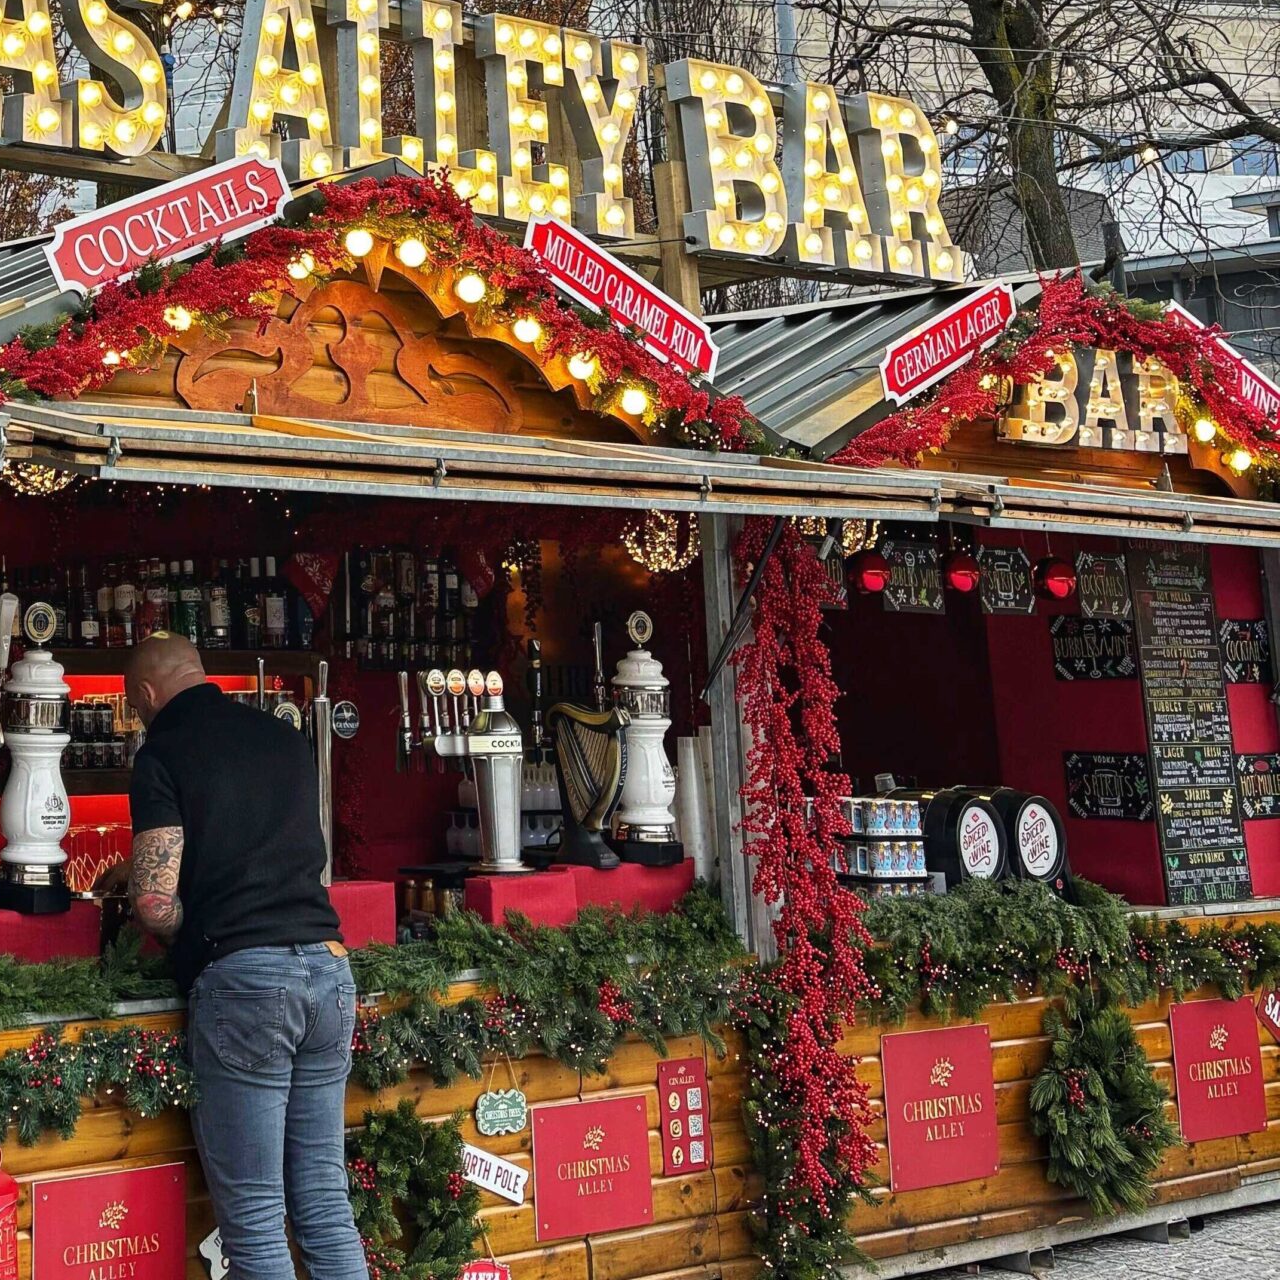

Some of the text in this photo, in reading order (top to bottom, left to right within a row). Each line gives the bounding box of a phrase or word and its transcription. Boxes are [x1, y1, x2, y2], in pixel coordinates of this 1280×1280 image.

[666, 58, 963, 283] BAR
[74, 170, 269, 277] COCKTAILS
[542, 229, 704, 367] MULLED CARAMEL RUM
[894, 297, 1004, 387] GERMAN LAGER
[998, 349, 1188, 454] BAR
[1081, 575, 1124, 597] COCKTAILS
[1198, 702, 1214, 712] WINE
[1093, 755, 1115, 764] VODKA
[1162, 747, 1184, 758] LAGER
[1083, 774, 1134, 797] SPIRITS
[1184, 789, 1210, 800] SPIRITS
[1240, 775, 1255, 796] HOT
[1099, 808, 1124, 817] BRANDY
[963, 822, 989, 850] SPICED
[1021, 819, 1046, 847] SPICED
[970, 841, 992, 865] WINE
[1029, 836, 1050, 860] WINE
[678, 1075, 695, 1085] ALLEY
[1189, 1057, 1252, 1082] CHRISTMAS
[1207, 1081, 1238, 1099] ALLEY
[903, 1093, 982, 1123] CHRISTMAS
[926, 1121, 965, 1141] ALLEY
[461, 1150, 521, 1194] ORTH POLE
[557, 1155, 630, 1180] CHRISTMAS
[578, 1178, 614, 1196] ALLEY
[63, 1233, 160, 1266] CHRISTMAS
[88, 1261, 137, 1280] ALLEY
